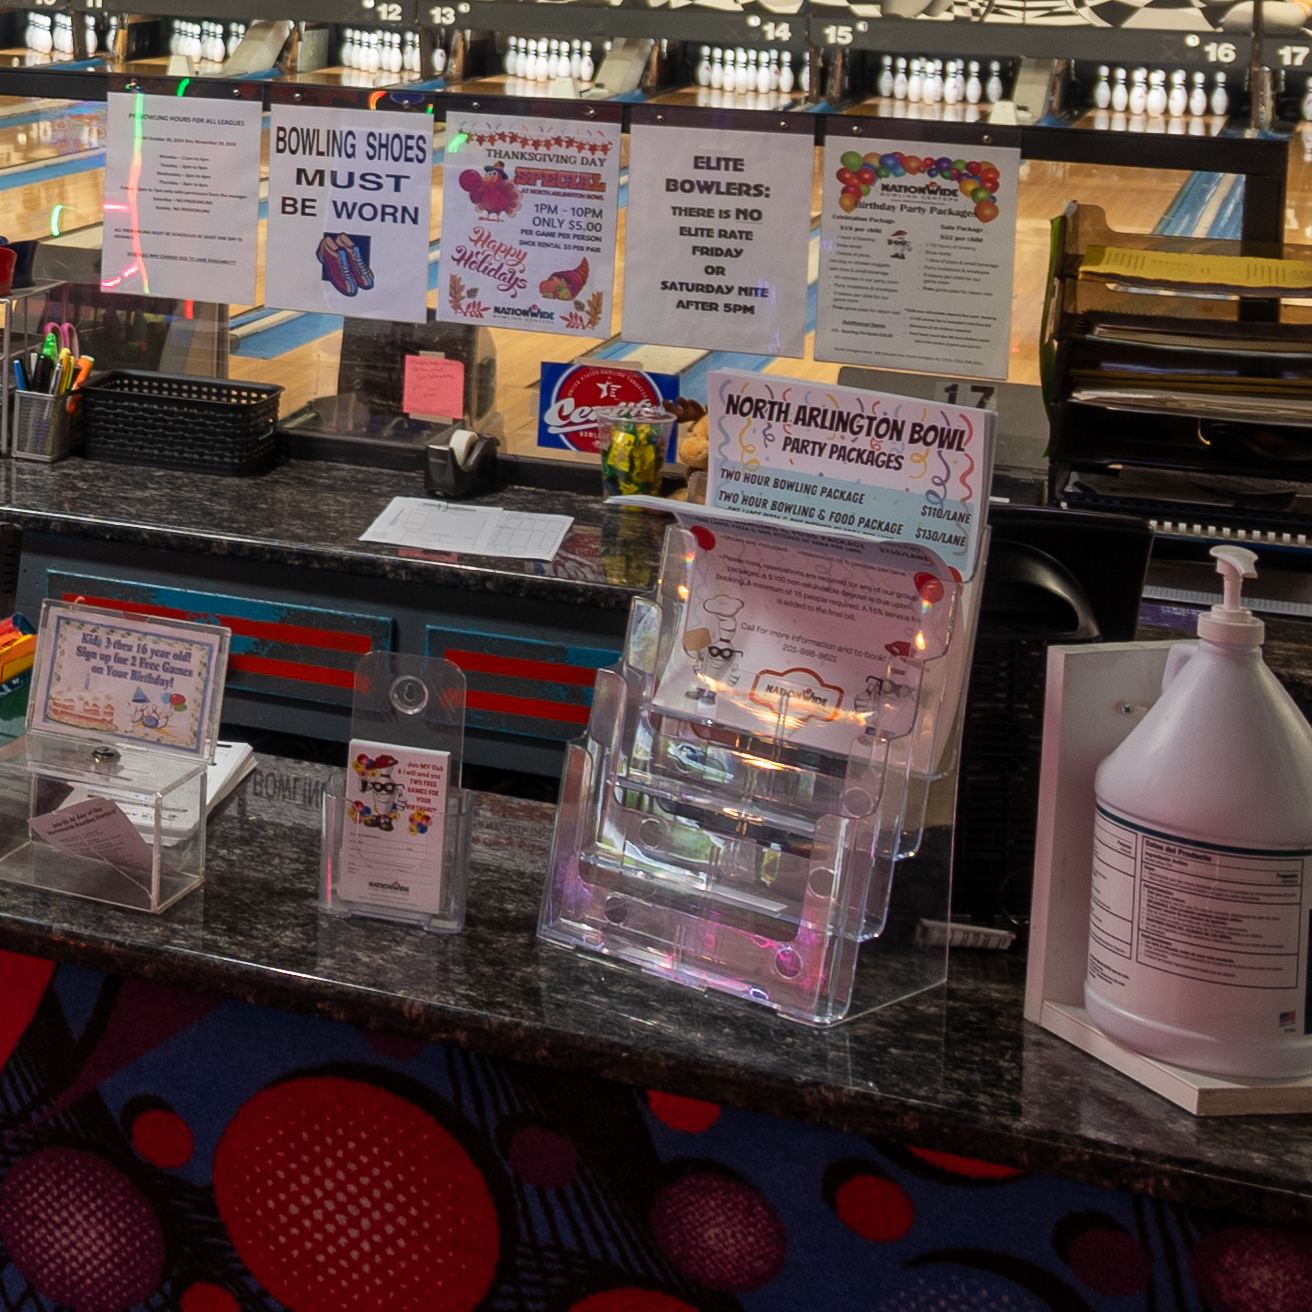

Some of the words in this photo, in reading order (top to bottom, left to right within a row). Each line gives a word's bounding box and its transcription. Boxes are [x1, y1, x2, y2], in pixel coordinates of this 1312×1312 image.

[432, 6, 455, 24] 13
[1204, 42, 1237, 63] 16
[1278, 46, 1311, 67] 17
[276, 126, 356, 159] BOWLING
[365, 130, 427, 164] SHOES
[295, 168, 411, 193] MUST
[514, 166, 606, 191] SPECIAL
[665, 178, 771, 198] BOWLERS:
[881, 183, 959, 197] NATIONWIDE
[282, 197, 317, 216] BE
[332, 200, 419, 225] WORN
[855, 201, 897, 213] Birthday
[900, 206, 926, 215] Party
[930, 207, 977, 218] Packages
[469, 227, 528, 273] Happy
[451, 246, 527, 298] Holidays
[494, 306, 555, 320] NATIONWIDE
[942, 383, 996, 408] 17
[725, 394, 790, 422] NORTH
[794, 404, 904, 442] ARLINGTON
[908, 427, 967, 453] BOWL
[782, 436, 827, 457] PARTY
[831, 444, 904, 471] PACKAGES
[720, 469, 742, 482] TWO
[743, 473, 770, 488] HOUR
[772, 478, 818, 496] BOWLING
[820, 486, 865, 504] PACKAGE
[718, 491, 741, 505] TWO
[742, 494, 769, 510] HOUR
[771, 499, 816, 518] BOWLING
[818, 508, 825, 520] &
[828, 510, 856, 526] FOOD
[858, 518, 904, 536] PACKAGE
[920, 505, 972, 525] $110/LANE
[915, 527, 967, 547] $130/LANE
[82, 633, 102, 648] Kids
[104, 638, 111, 648] 3
[114, 640, 133, 652] thru
[136, 642, 148, 654] 16
[150, 647, 170, 660] year
[173, 650, 192, 663] old!
[76, 646, 97, 662] Sign
[100, 654, 111, 665] up
[113, 654, 128, 665] for
[130, 655, 137, 666] 2
[139, 656, 159, 670] Free
[162, 663, 193, 678] Games
[91, 666, 104, 674] on
[106, 665, 128, 679] Your
[130, 670, 174, 688] Birthday!
